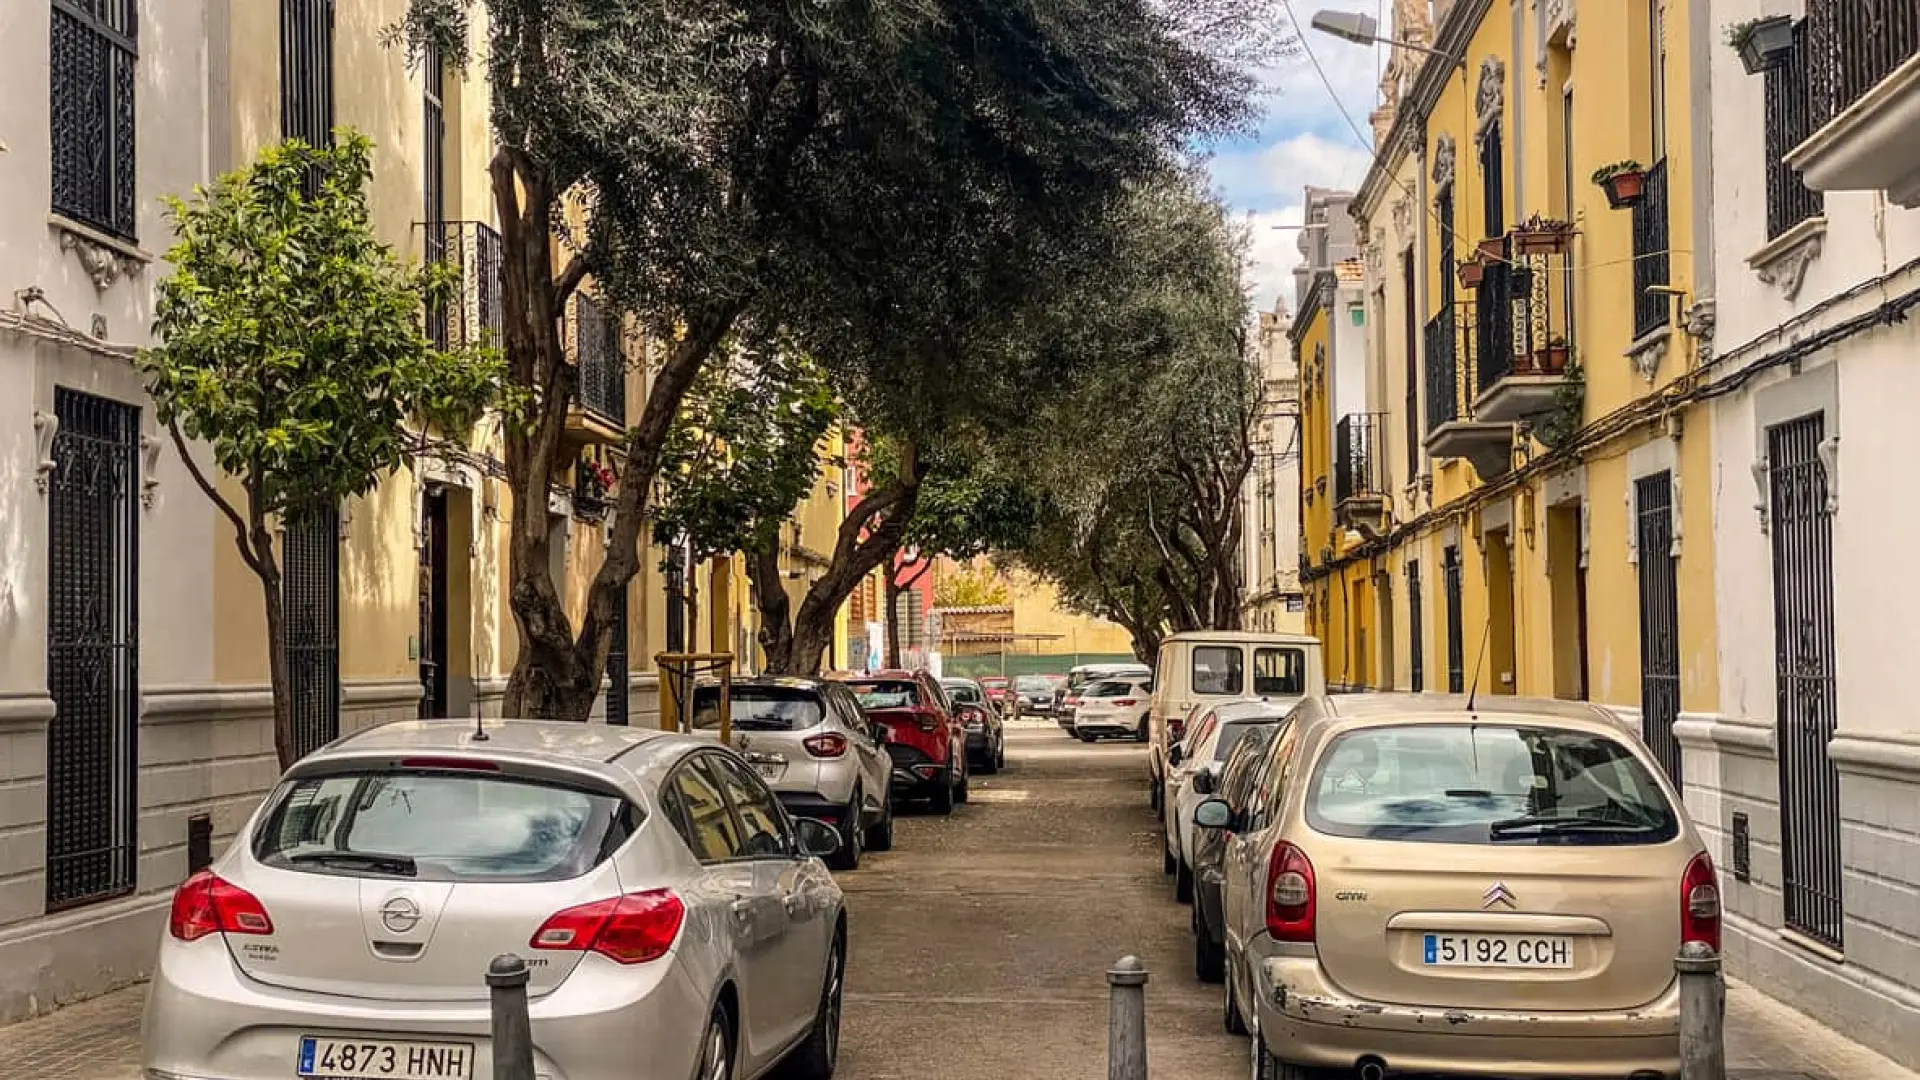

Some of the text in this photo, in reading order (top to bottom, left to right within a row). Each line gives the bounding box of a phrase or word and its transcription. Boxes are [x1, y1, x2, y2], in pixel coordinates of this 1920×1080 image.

[1441, 937, 1567, 964] 5192 CCH
[320, 1042, 464, 1077] 4873 HNH
